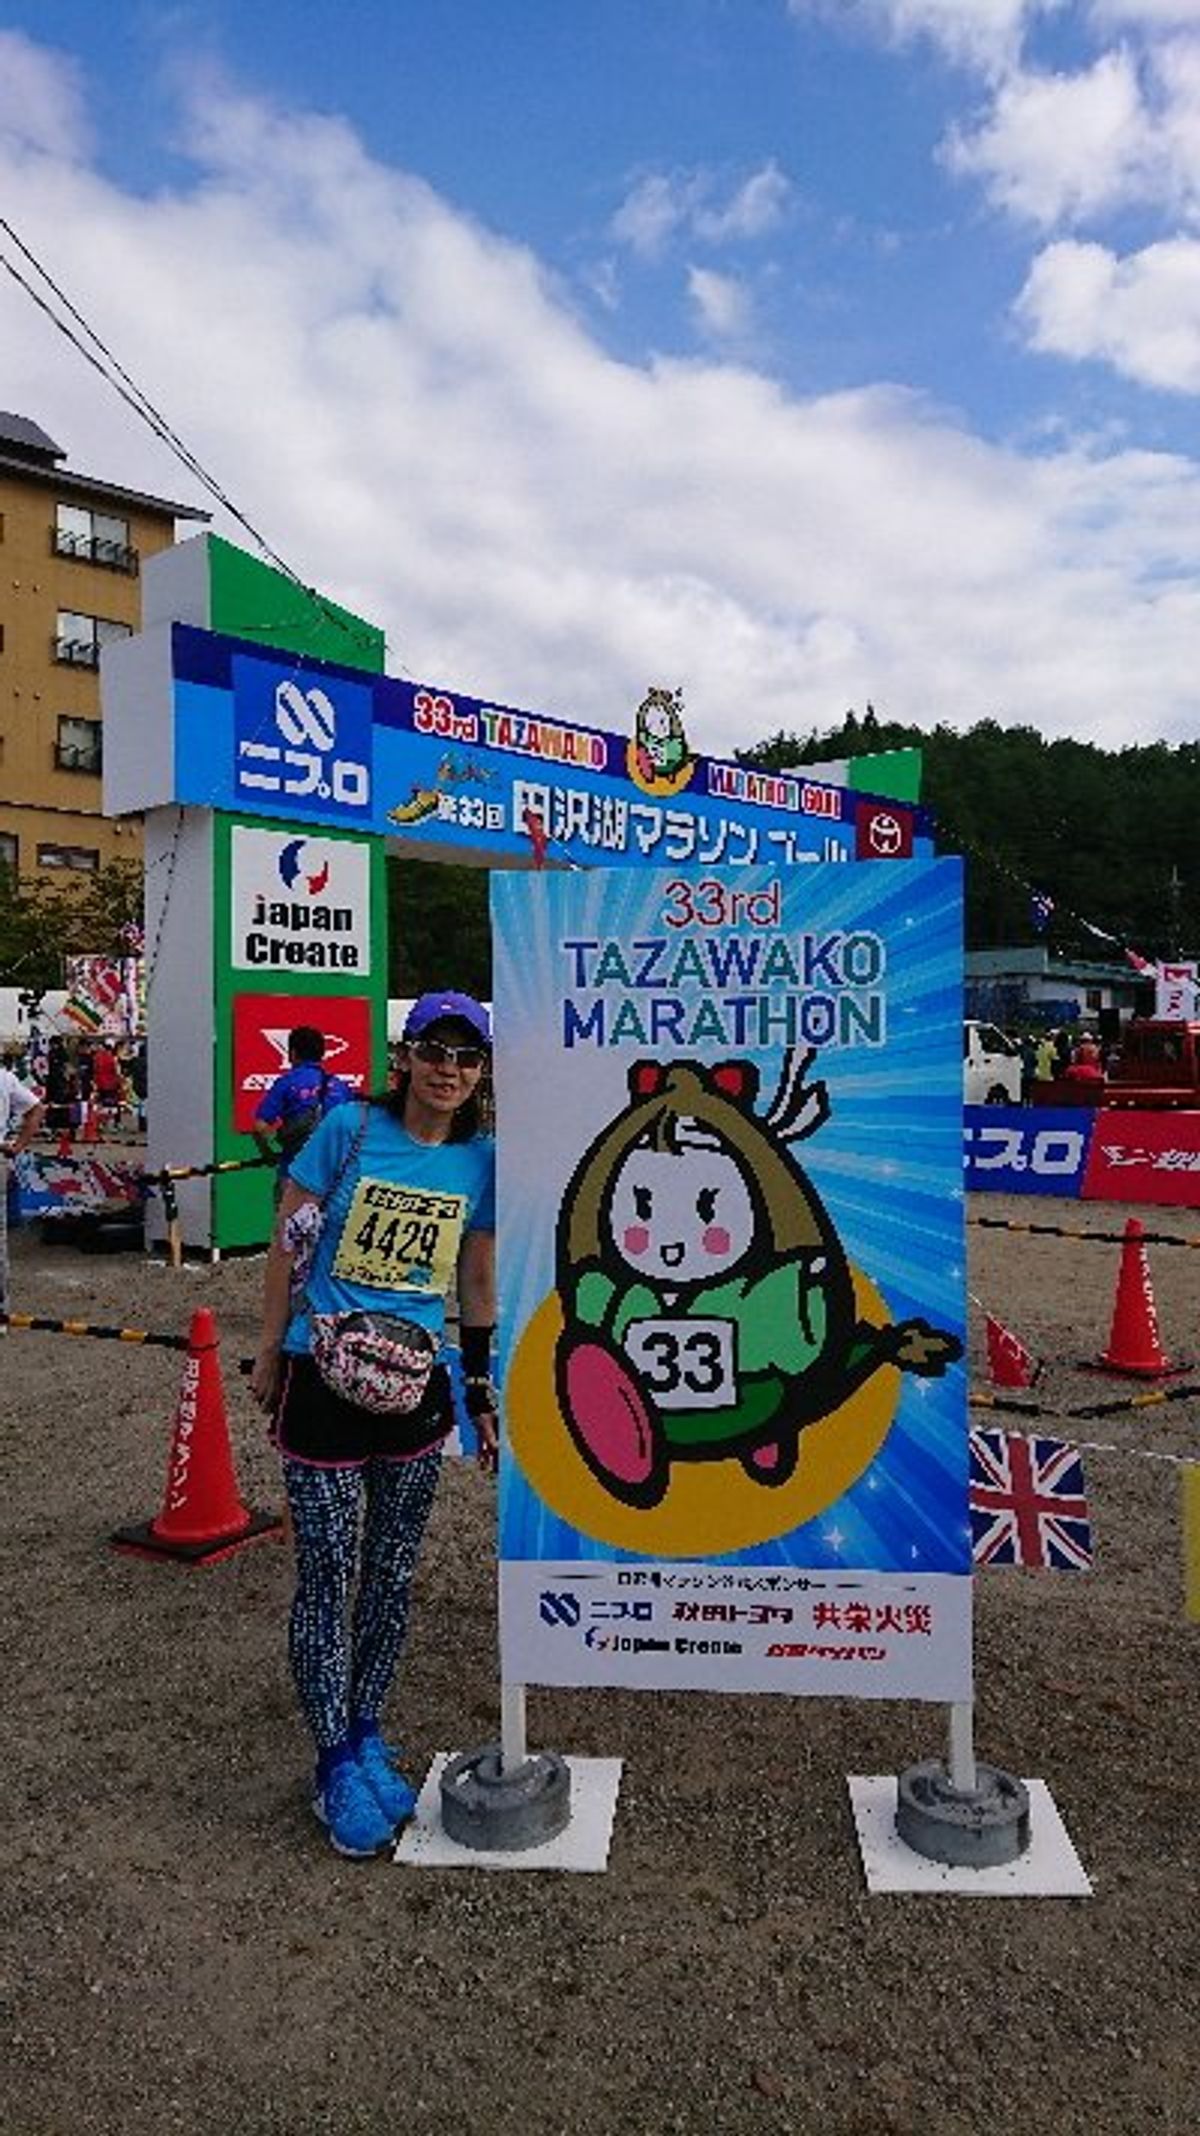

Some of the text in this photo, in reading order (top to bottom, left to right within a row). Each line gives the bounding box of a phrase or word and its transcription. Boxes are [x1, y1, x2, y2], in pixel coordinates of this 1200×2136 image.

[415, 694, 478, 741] 33rd
[480, 708, 607, 770] TAZAWAKO
[240, 741, 369, 805] ニプロ
[708, 762, 799, 811] MARATHON
[513, 780, 757, 864] 田沢湖マラソン
[665, 880, 779, 928] 33rd
[246, 933, 359, 968] Create
[562, 935, 886, 989] TAZAWAKO
[562, 995, 885, 1049] MARATHON
[963, 1127, 1085, 1175] プロ
[353, 1211, 440, 1266] 4429
[641, 1332, 725, 1393] 33
[672, 1601, 794, 1625] 秋田トヨタ
[813, 1601, 932, 1636] 共栄火災
